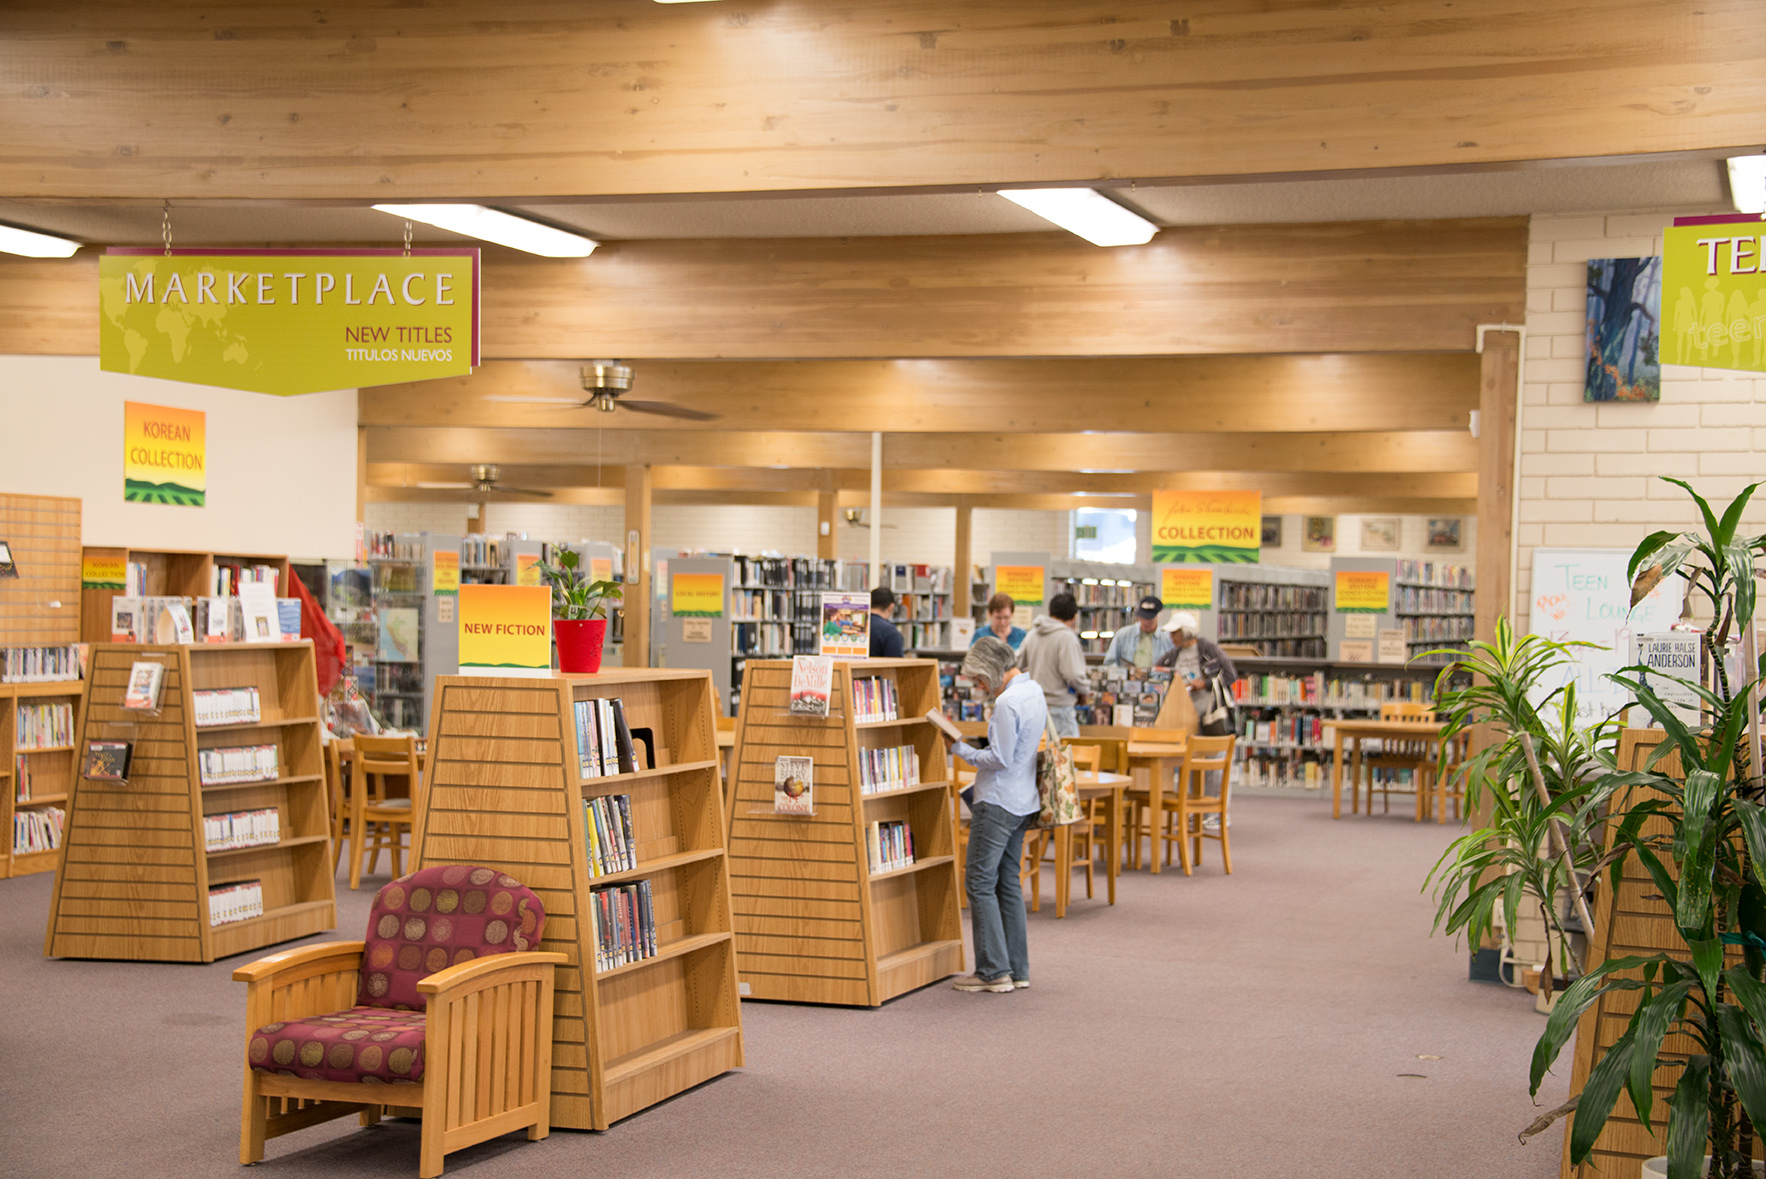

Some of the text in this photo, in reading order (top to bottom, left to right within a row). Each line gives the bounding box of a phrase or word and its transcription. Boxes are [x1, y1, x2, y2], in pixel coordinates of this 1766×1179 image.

[1696, 235, 1766, 276] TE
[125, 272, 456, 306] MARKETPLACE
[345, 327, 453, 343] NEW TITLES
[345, 348, 453, 362] TITULOS NUEVOS
[143, 420, 191, 443] KOREAN
[131, 446, 203, 471] COLLECTION
[1157, 526, 1254, 540] COLLECTION
[92, 561, 120, 569] KOREAN
[85, 570, 126, 578] COLLECTION
[1554, 563, 1608, 591] TEEN
[1586, 597, 1656, 624] LOUNGE
[464, 623, 546, 636] NEW FICTION
[1648, 642, 1696, 653] LAURIE HALSE
[798, 660, 828, 675] Nelson
[1647, 653, 1696, 668] ANDERSON
[794, 674, 828, 688] DeMille
[780, 760, 806, 771] STEVE
[780, 770, 806, 780] BERRY
[778, 802, 809, 813] COLONY
